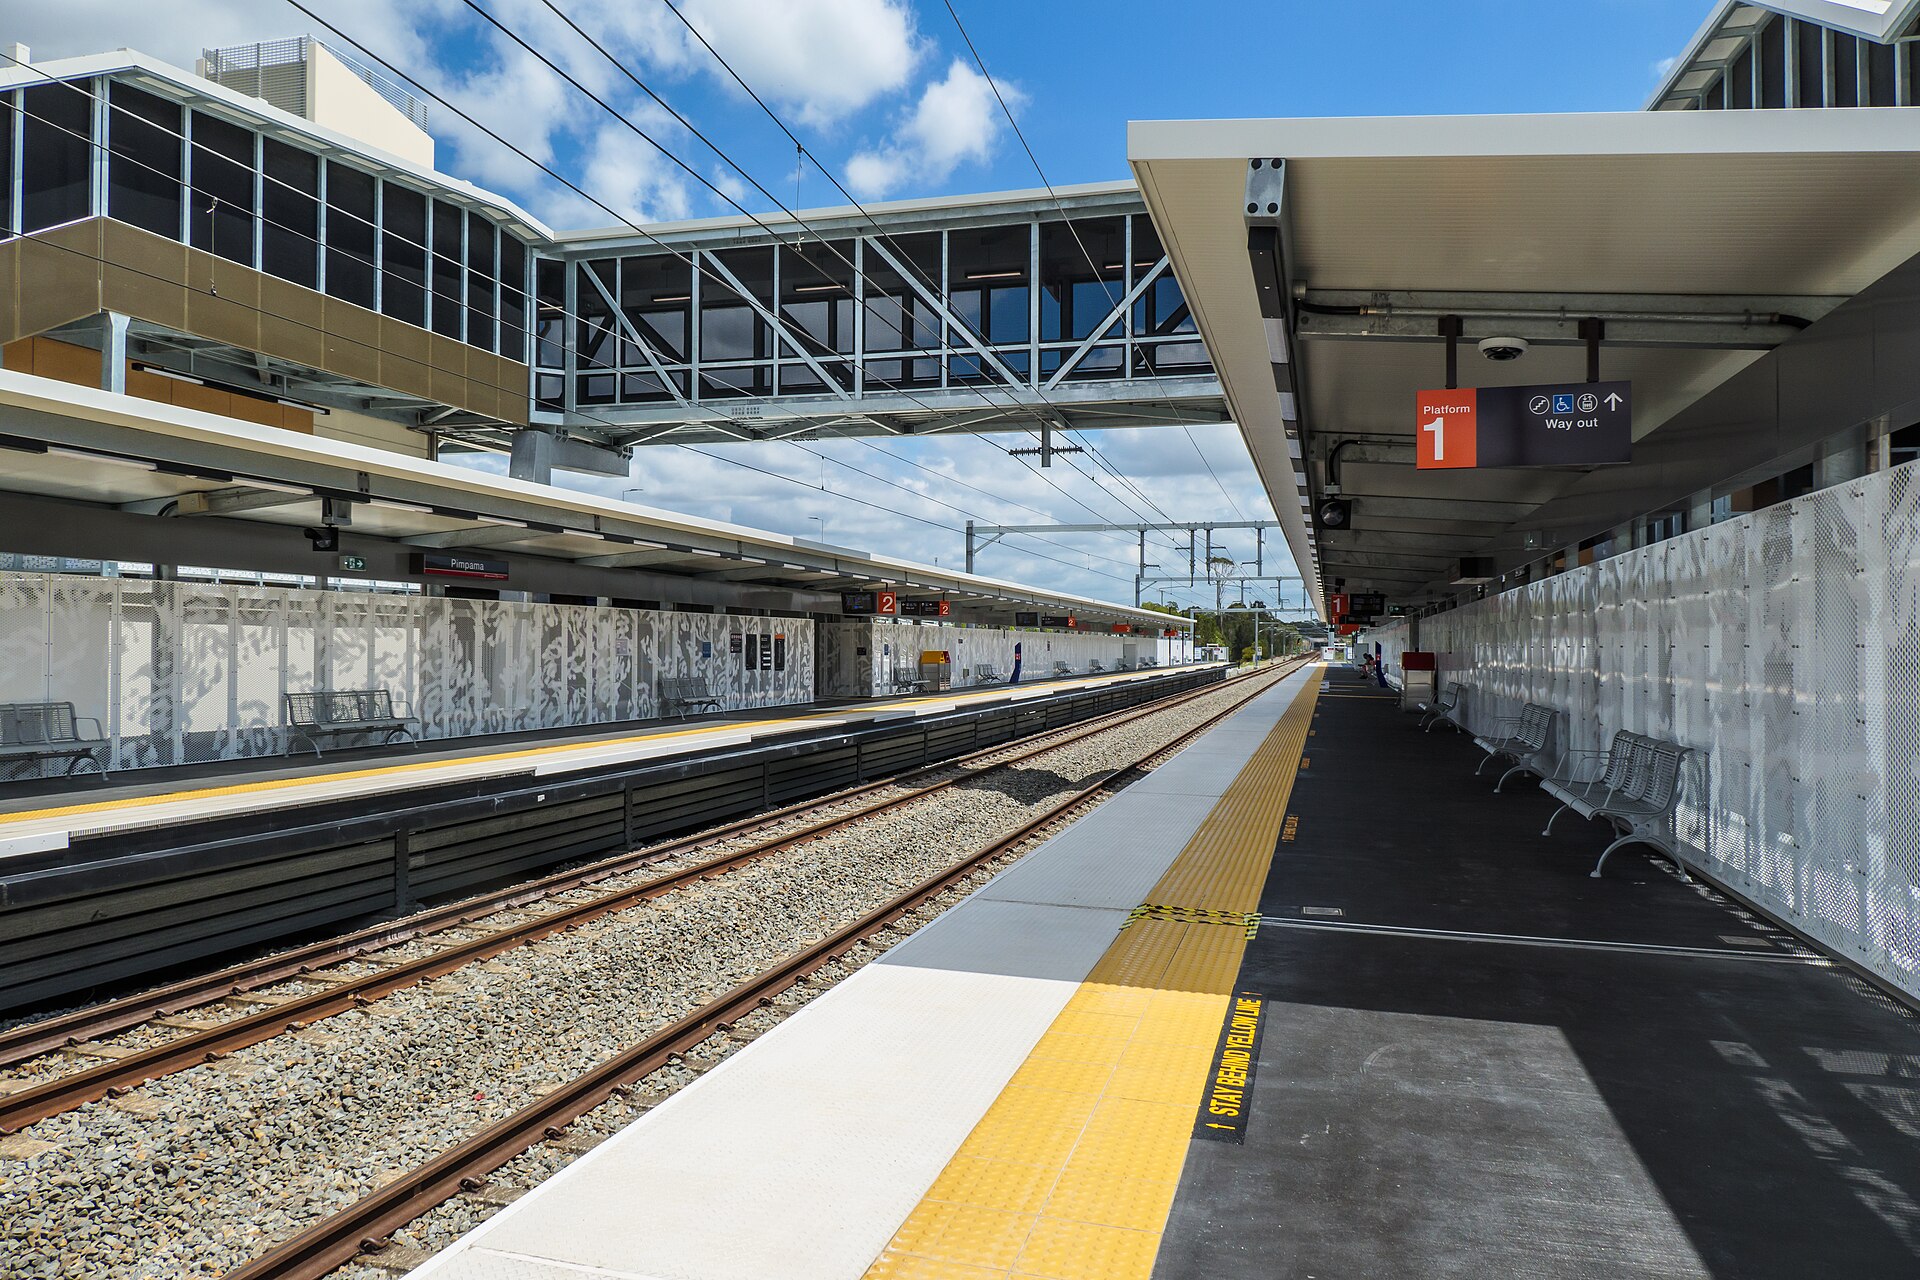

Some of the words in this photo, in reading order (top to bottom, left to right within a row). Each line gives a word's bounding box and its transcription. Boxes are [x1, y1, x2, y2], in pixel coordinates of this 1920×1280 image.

[1423, 405, 1470, 415] Platform
[1545, 419, 1573, 431] Way
[1577, 417, 1598, 428] out
[1423, 417, 1443, 460] 1
[451, 558, 485, 571] Pimpama
[882, 596, 893, 612] 2
[942, 605, 949, 614] 2
[1333, 598, 1340, 612] 1
[1234, 998, 1262, 1017] LINE
[1226, 1014, 1258, 1049] YELLOW
[1216, 1050, 1250, 1087] BEHIND
[1209, 1085, 1243, 1117] STAY
